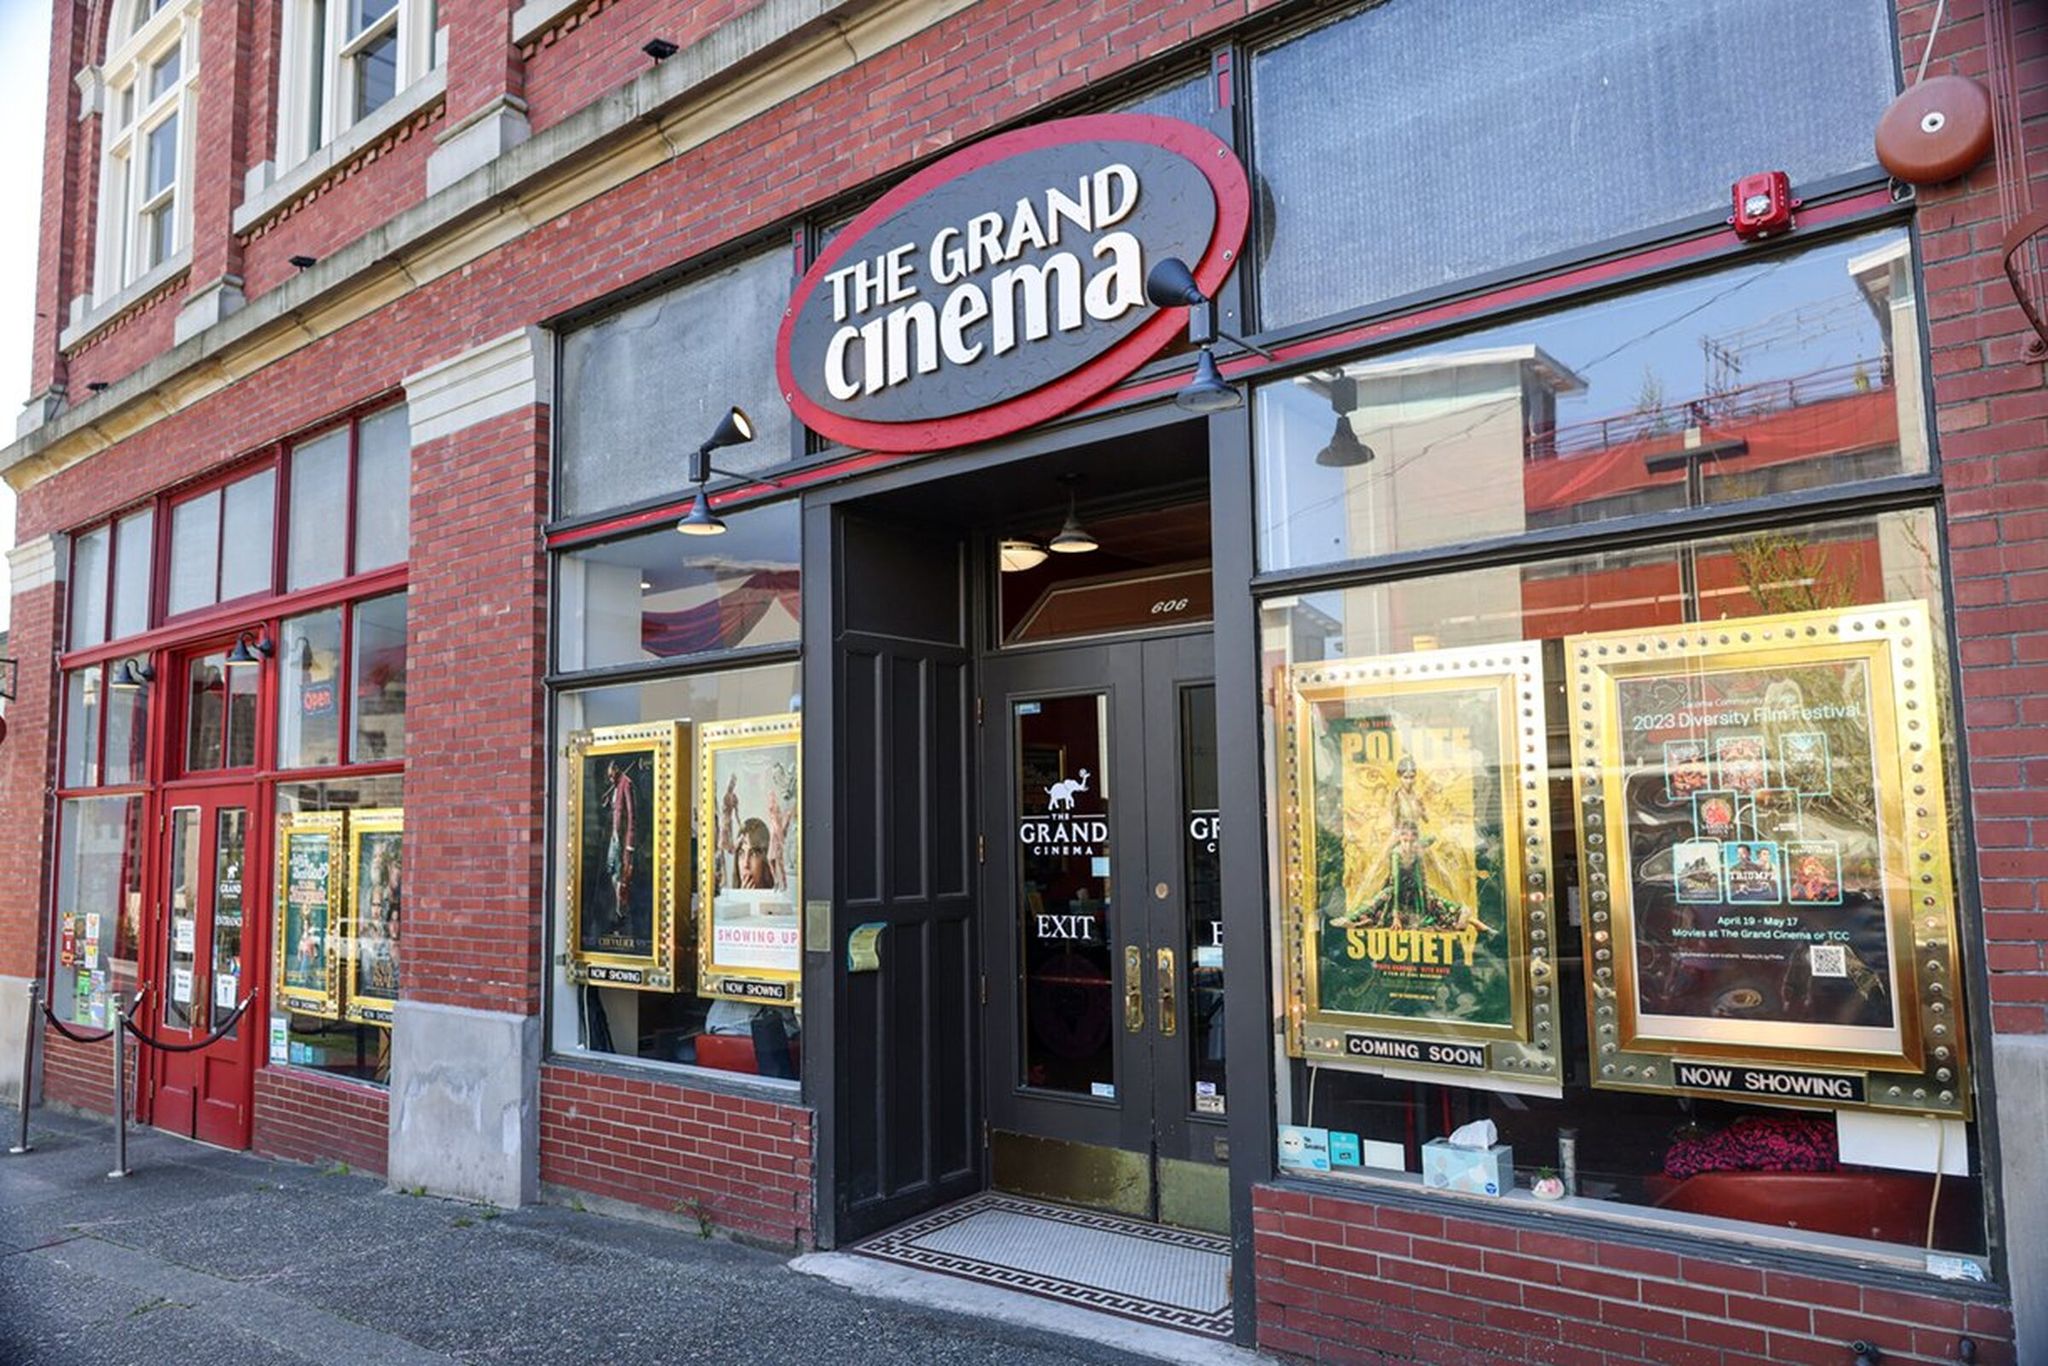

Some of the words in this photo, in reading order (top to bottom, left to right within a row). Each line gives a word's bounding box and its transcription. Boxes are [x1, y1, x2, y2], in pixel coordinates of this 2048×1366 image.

[824, 242, 918, 322] THE
[929, 163, 1139, 285] GRAND
[824, 231, 1145, 400] cinema
[1151, 598, 1189, 614] 606
[1633, 715, 1675, 731] 2023
[1679, 710, 1750, 728] Diversity
[1754, 707, 1792, 723] Film
[1795, 702, 1861, 721] Festival
[1019, 822, 1108, 844] GRAND
[1033, 846, 1094, 856] CINEMA
[1036, 914, 1096, 940] EXIT
[1717, 916, 1742, 927] April
[1744, 916, 1756, 926] 19
[1764, 917, 1784, 928] May
[1786, 917, 1799, 927] 17
[718, 929, 775, 944] SHOWING
[781, 931, 798, 944] UP
[1672, 928, 1707, 939] Movies
[1708, 929, 1719, 939] at
[1721, 928, 1739, 939] The
[1740, 929, 1772, 940] Grand
[1773, 930, 1812, 941] Cinema
[1814, 932, 1824, 941] or
[1828, 931, 1850, 942] TCC
[1346, 927, 1478, 967] SOCIETY
[590, 968, 607, 979] NOW
[608, 970, 641, 983] SHOWING
[725, 981, 743, 994] NOW
[747, 982, 783, 998] SHOWING
[1349, 1038, 1420, 1059] COMING
[1429, 1045, 1484, 1065] SOON
[1681, 1067, 1732, 1088] NOW
[1745, 1072, 1852, 1098] SHOWING
